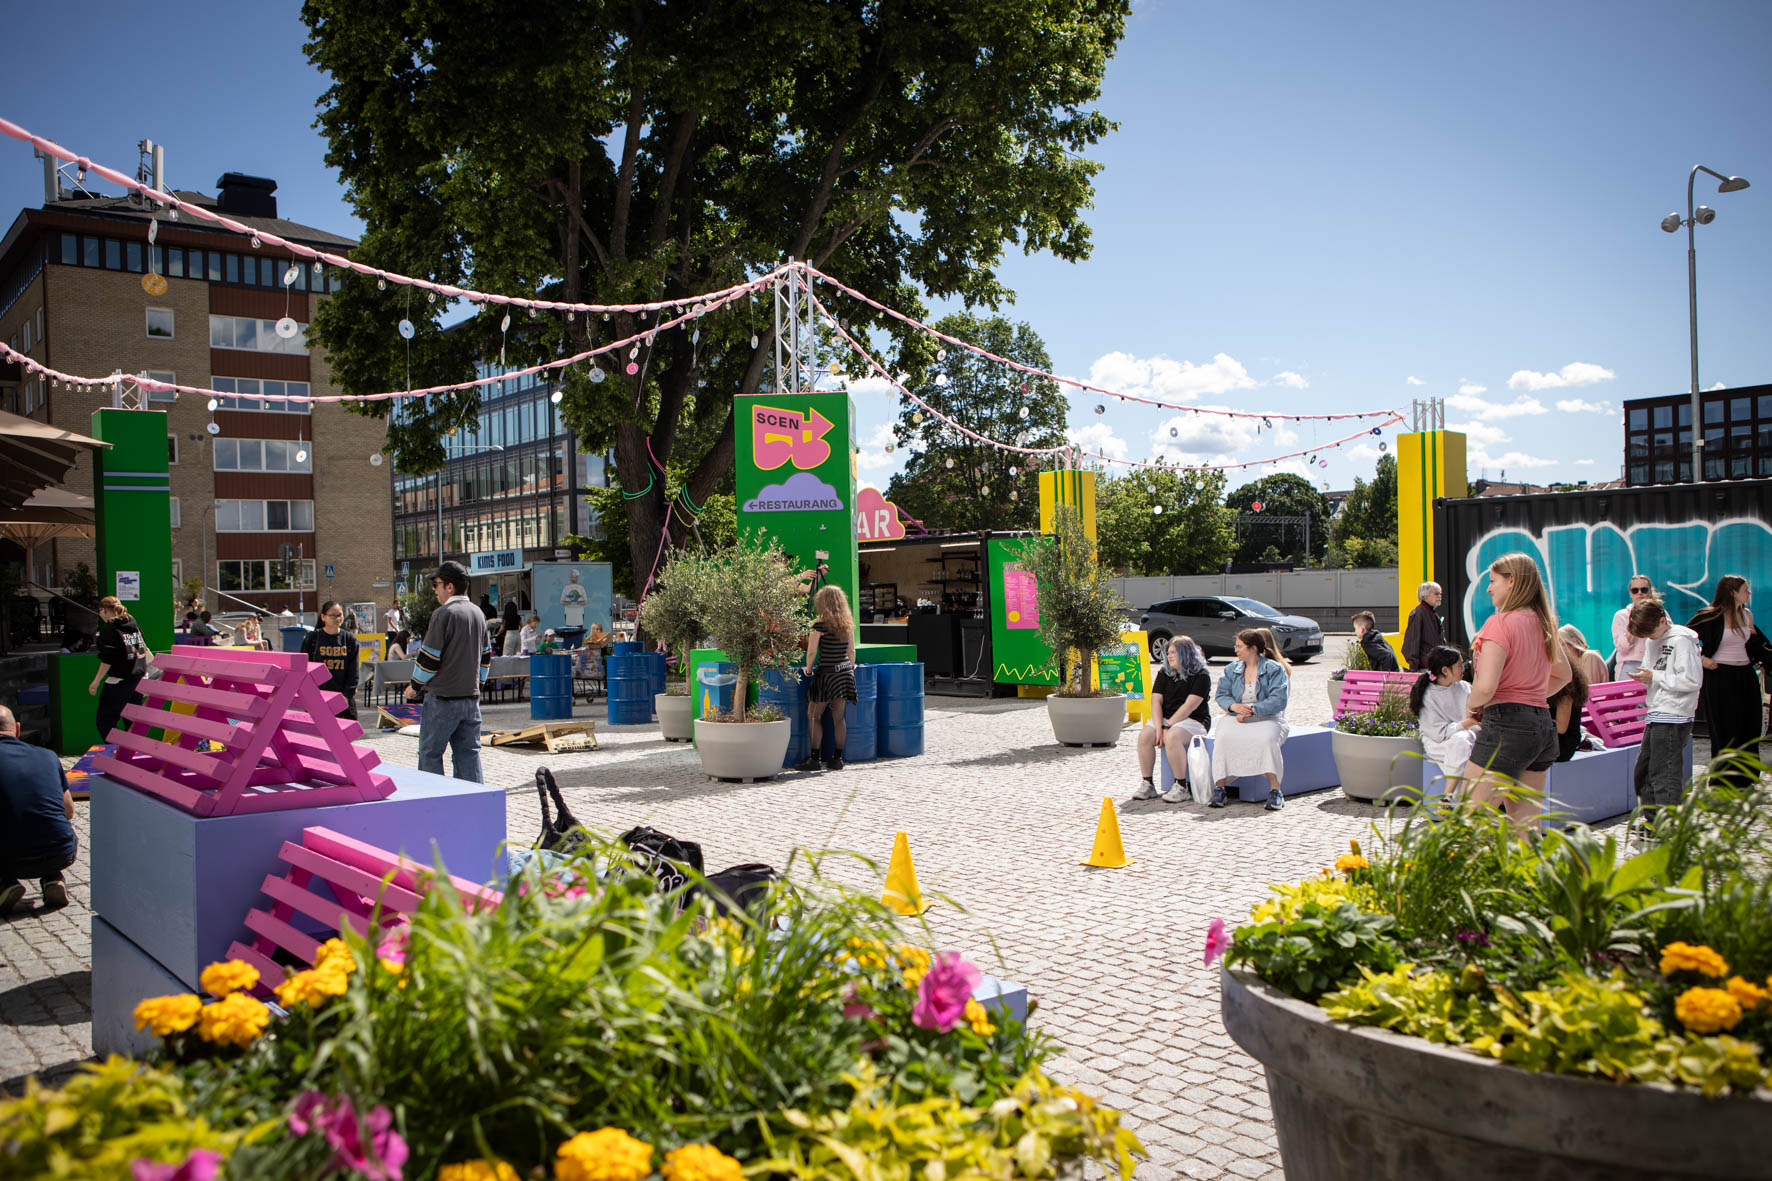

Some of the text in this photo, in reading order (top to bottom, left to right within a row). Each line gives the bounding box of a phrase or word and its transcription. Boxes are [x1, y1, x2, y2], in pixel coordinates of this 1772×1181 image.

[756, 413, 799, 430] SCEN
[758, 499, 838, 510] RESTAURANG
[857, 509, 890, 538] AR
[477, 552, 515, 569] KIMS FOOD
